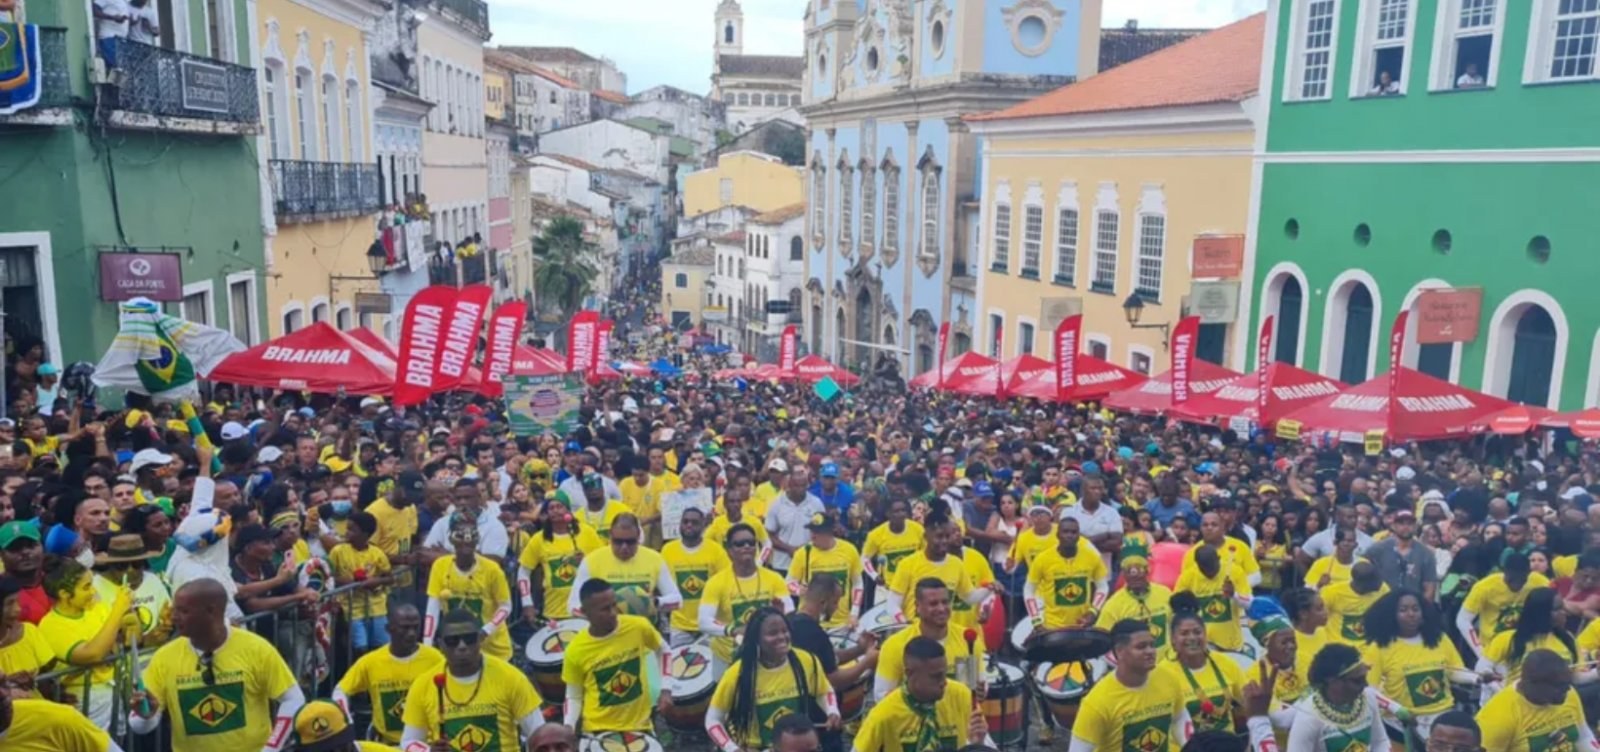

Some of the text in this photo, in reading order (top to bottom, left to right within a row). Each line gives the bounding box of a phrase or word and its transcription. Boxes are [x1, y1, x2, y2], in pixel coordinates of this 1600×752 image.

[262, 346, 351, 364] BRAHMA
[405, 304, 443, 387] BRAHMA
[440, 301, 480, 377] BRAHMA
[1061, 330, 1075, 388] BRAHMA
[1174, 334, 1191, 400] BRAHMA
[1271, 380, 1340, 400] BRAHMA
[1397, 394, 1476, 412] BRAHMA
